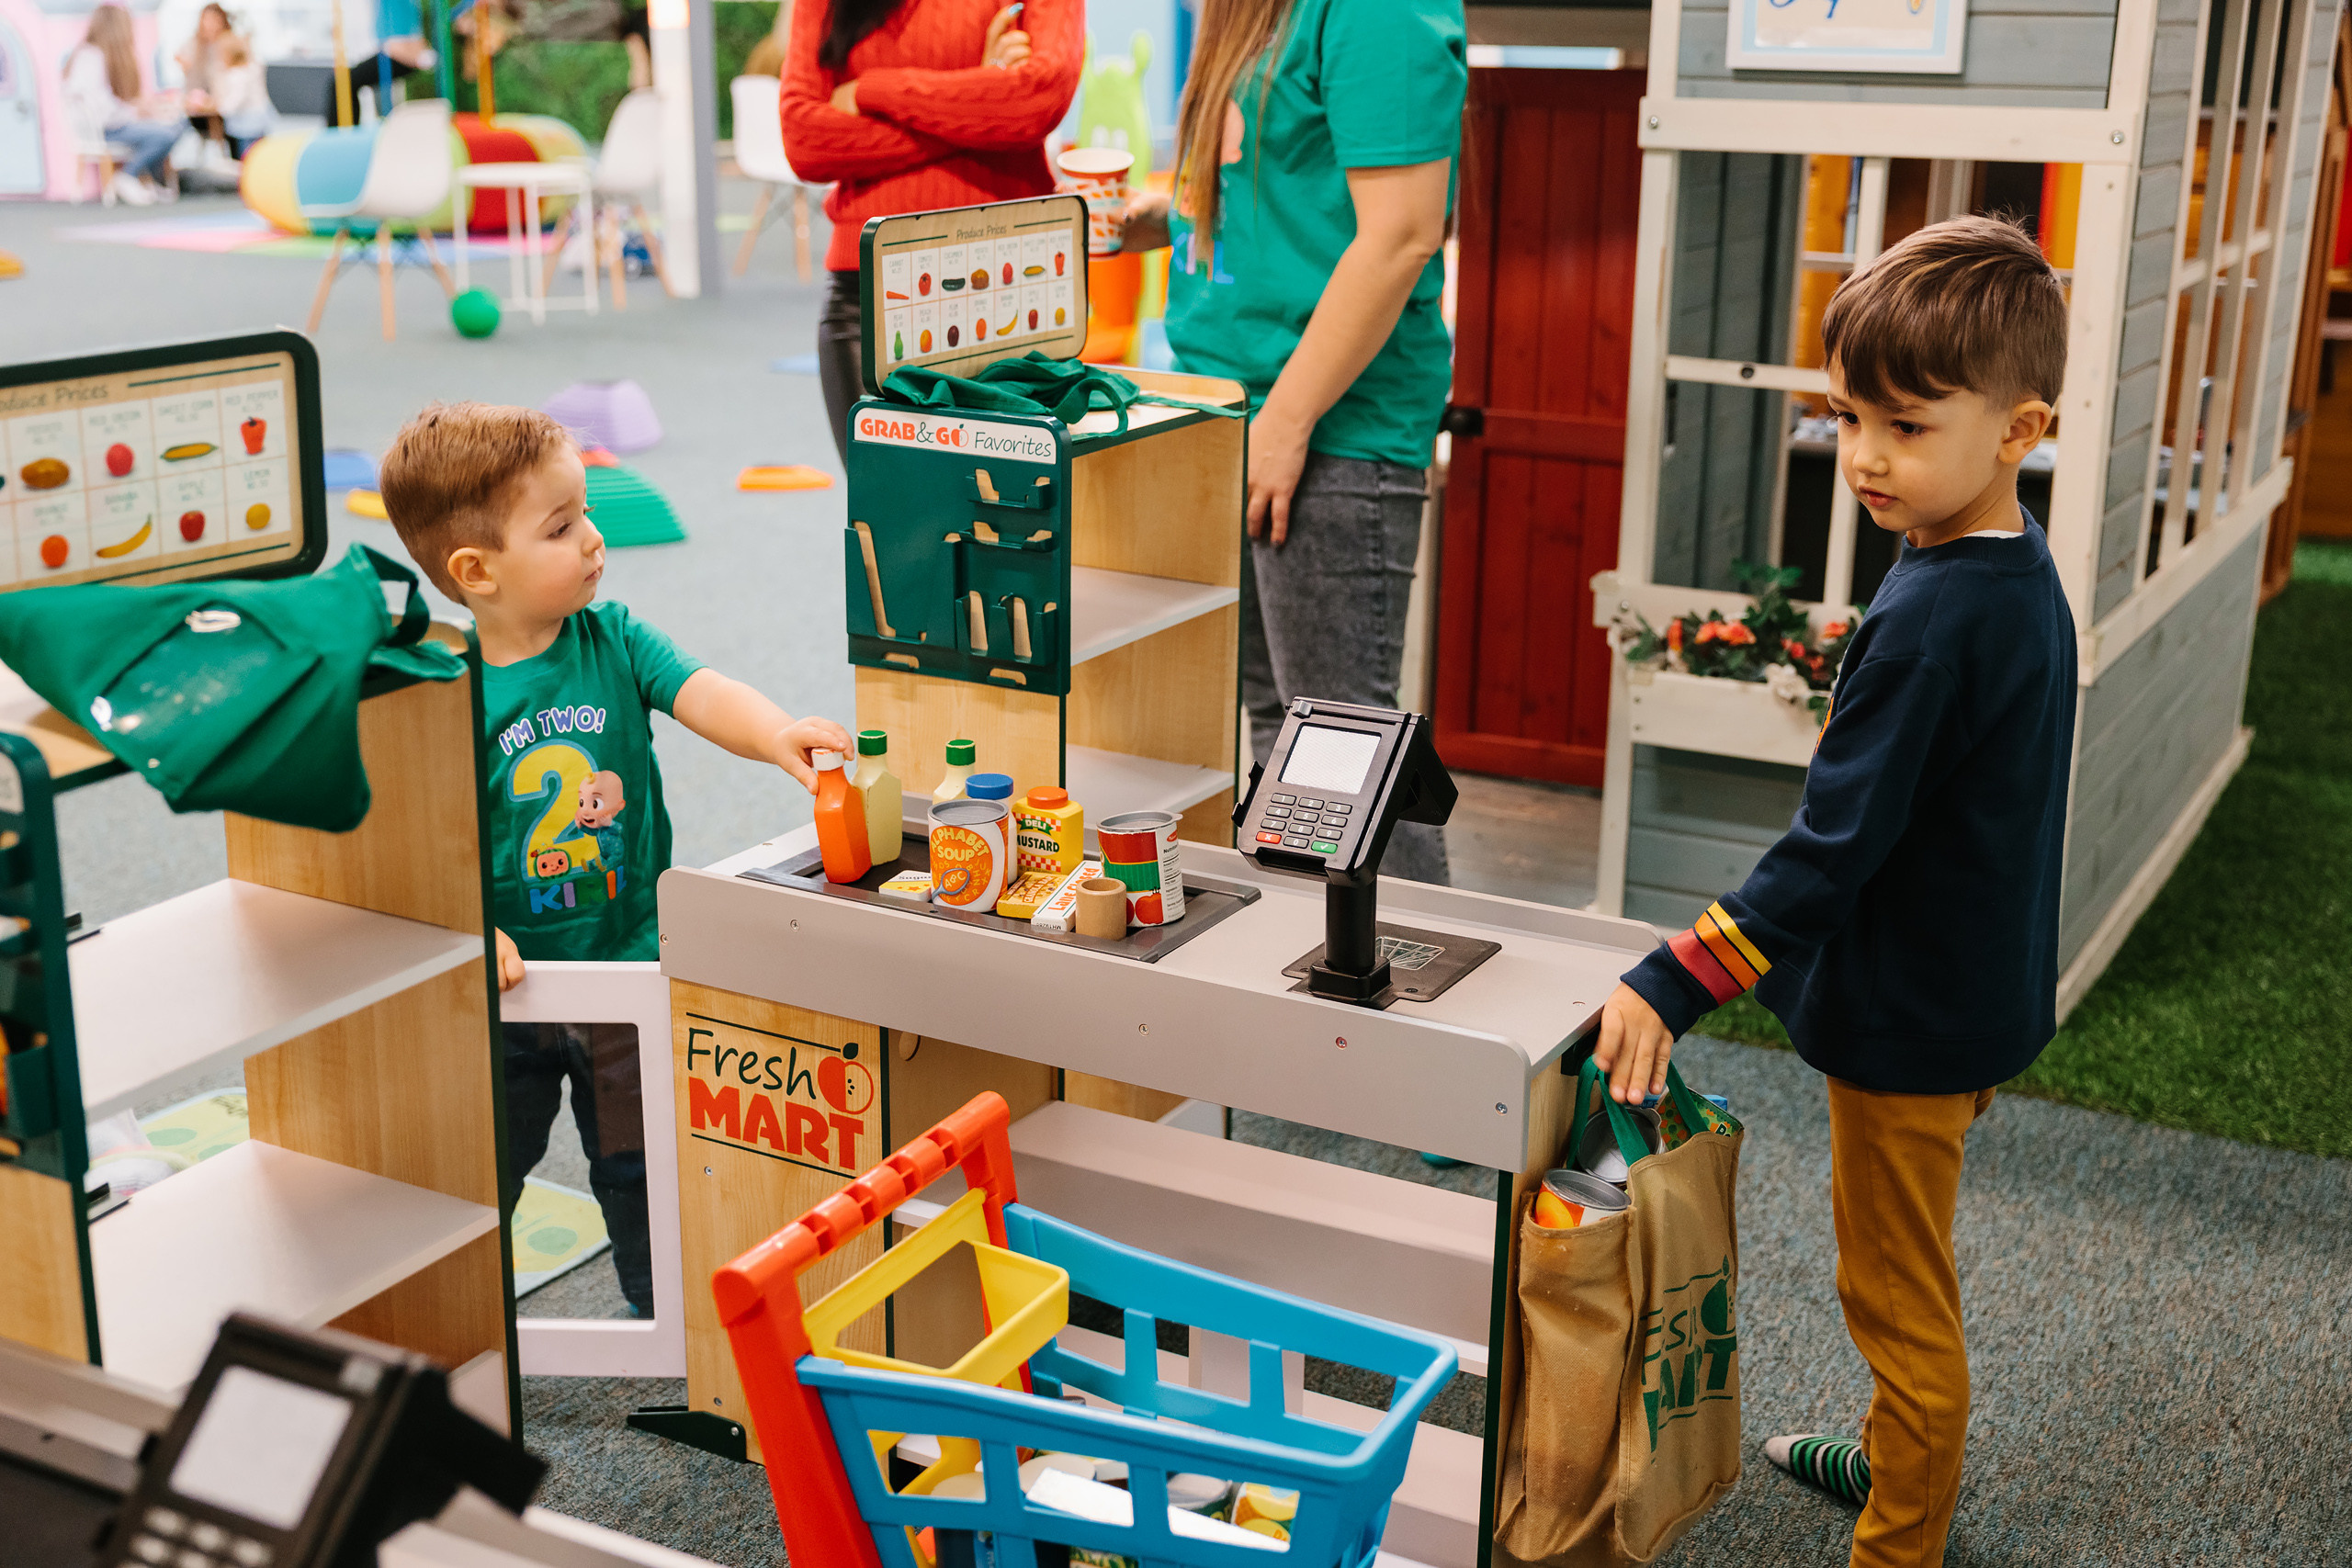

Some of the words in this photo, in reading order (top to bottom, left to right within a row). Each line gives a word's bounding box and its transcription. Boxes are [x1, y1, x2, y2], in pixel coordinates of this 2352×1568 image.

[956, 228, 984, 241] Produce
[987, 225, 1007, 237] Prices
[974, 432, 1053, 457] Favorites
[498, 717, 536, 756] I'M
[537, 705, 606, 737] TWO!
[507, 738, 603, 883] 2
[1024, 819, 1046, 830] DELI
[931, 827, 989, 857] ALPHABET
[937, 845, 976, 862] SOUP
[944, 871, 966, 888] ABC
[1047, 891, 1077, 911] Lane
[687, 1027, 817, 1100] Fresh
[688, 1076, 865, 1170] MART
